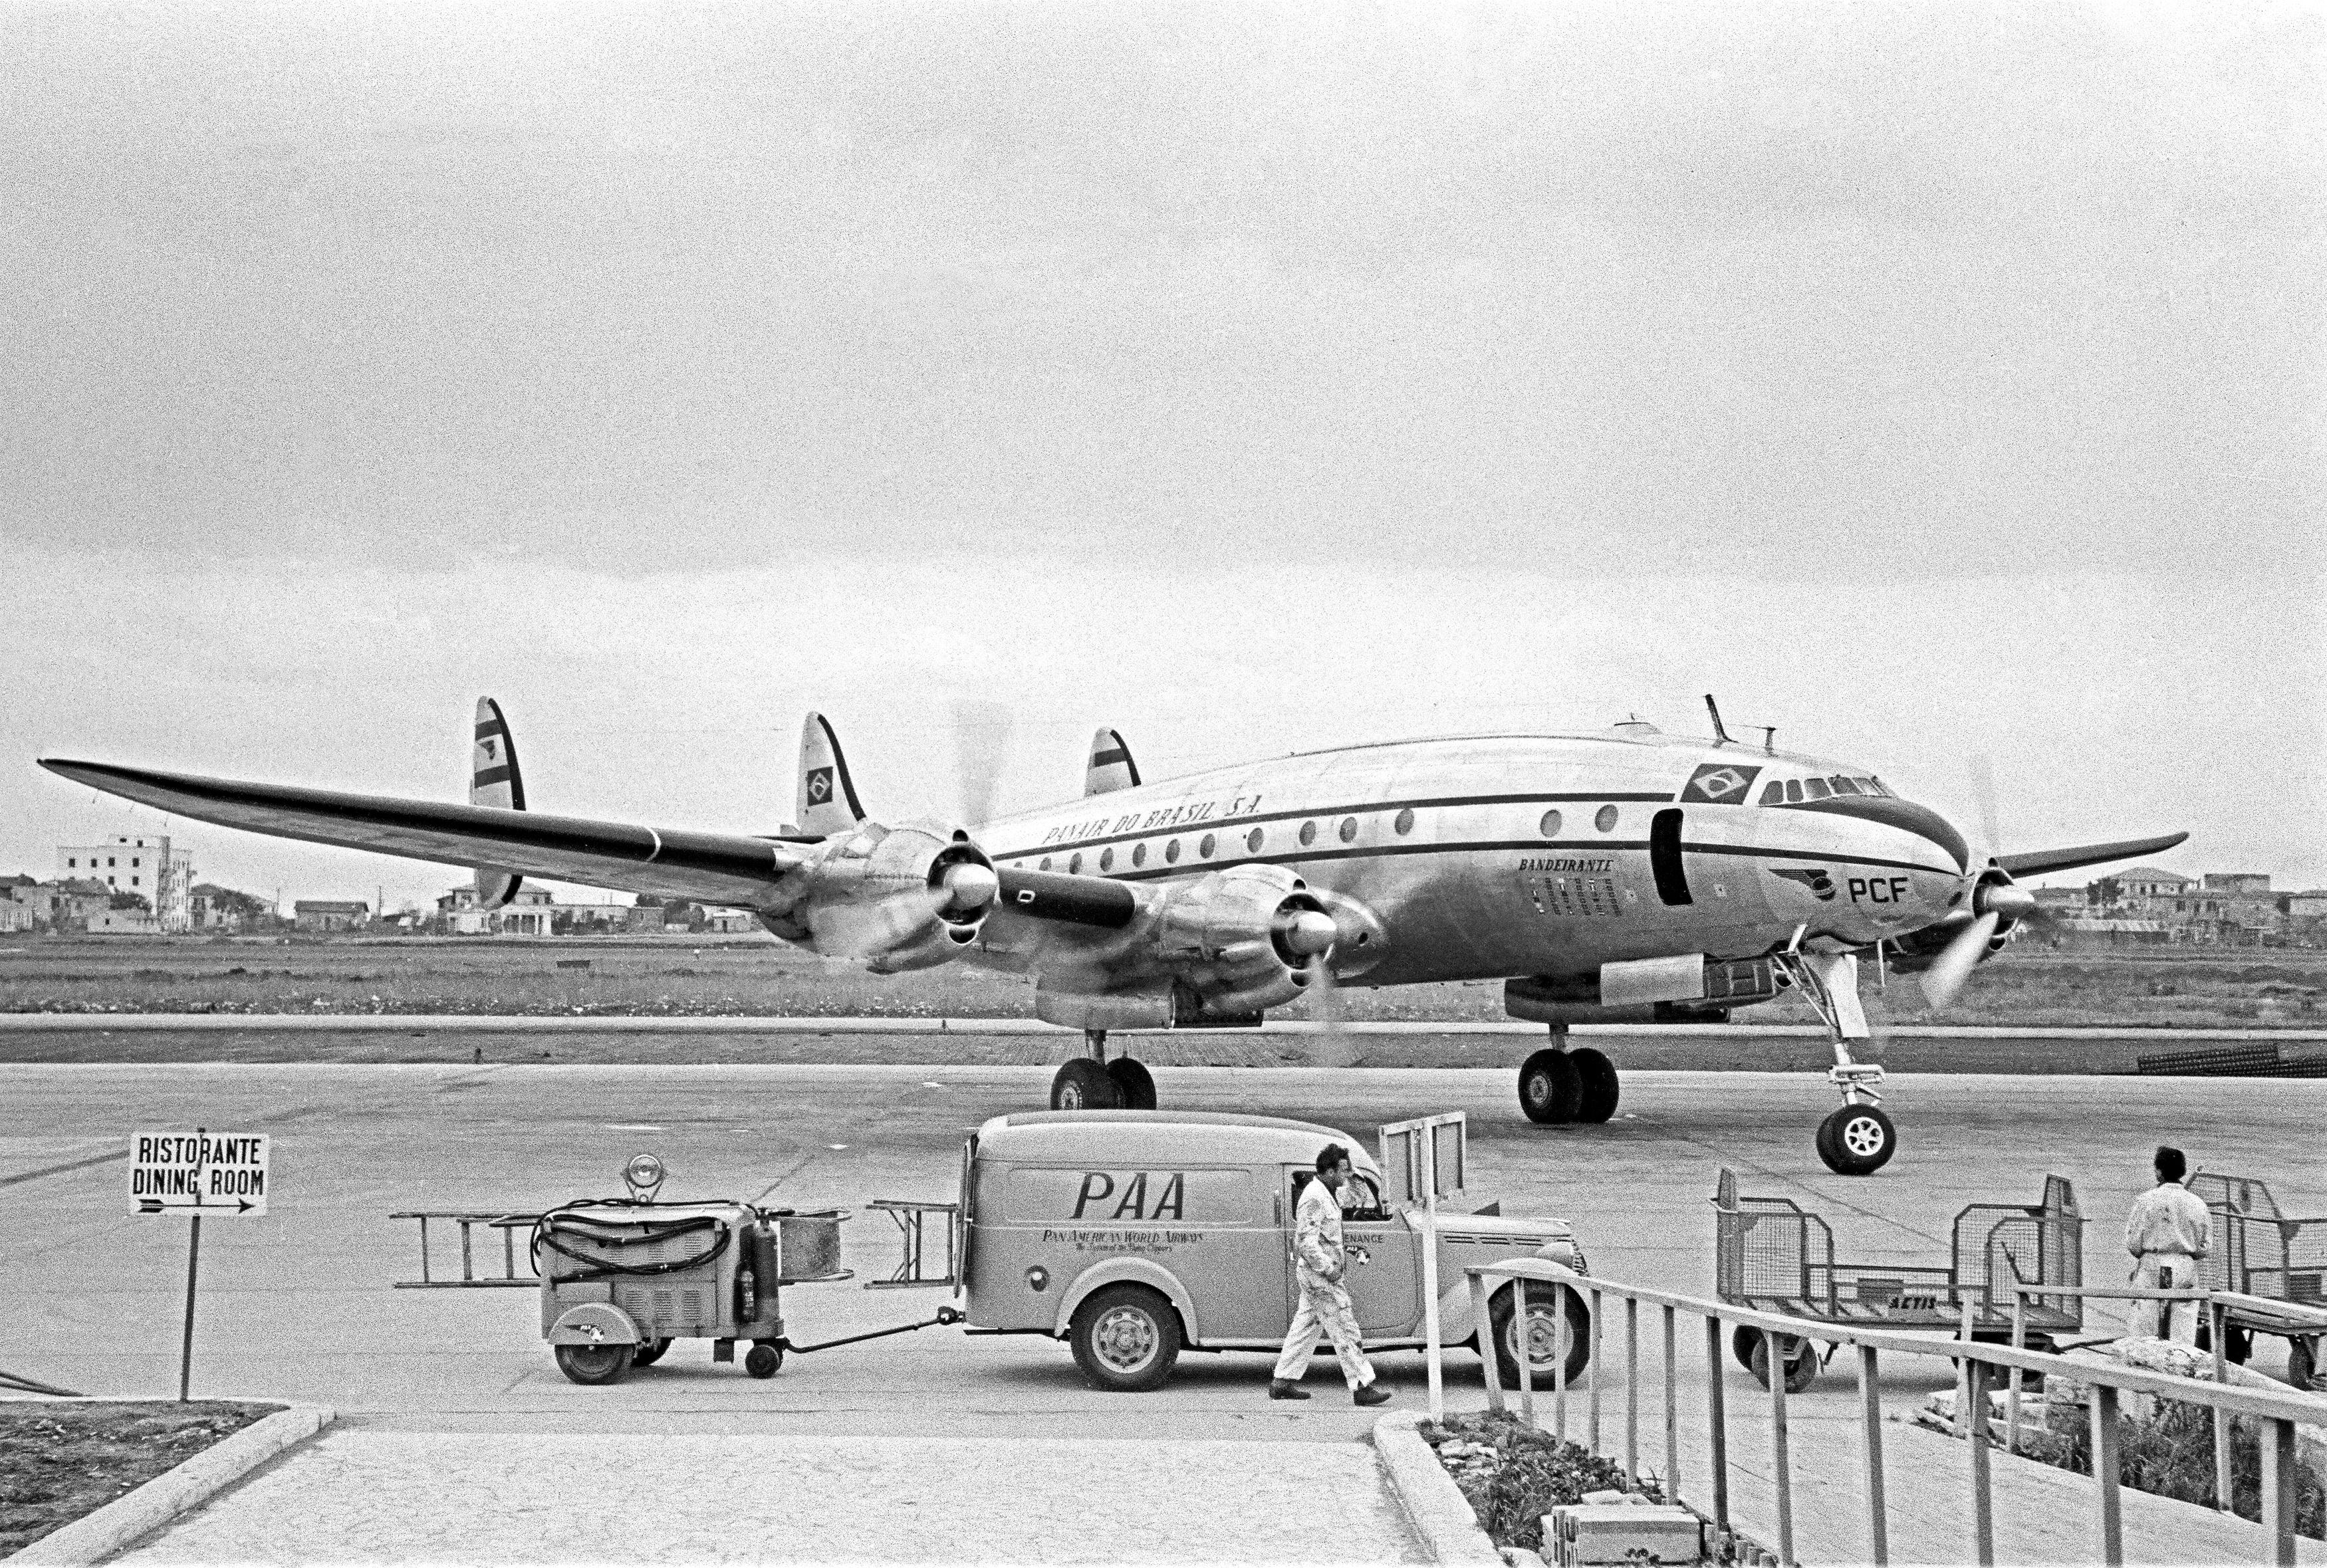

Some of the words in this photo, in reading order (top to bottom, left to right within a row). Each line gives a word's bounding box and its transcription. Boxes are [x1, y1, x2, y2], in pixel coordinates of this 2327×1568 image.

[1041, 818, 1110, 844] PANAIR
[1112, 814, 1141, 834] DO
[1519, 859, 1614, 872] BANDEIRANTE
[1848, 877, 1908, 903] PCF
[138, 1137, 261, 1164] RISTORANTE
[133, 1168, 198, 1195] DINING
[210, 1169, 264, 1196] ROOM
[1068, 1172, 1184, 1220] PAA
[1042, 1230, 1066, 1242] PAN
[1067, 1230, 1123, 1242] AMERICAN
[1124, 1230, 1160, 1243] WORLD
[1343, 1234, 1384, 1244] ENANCE
